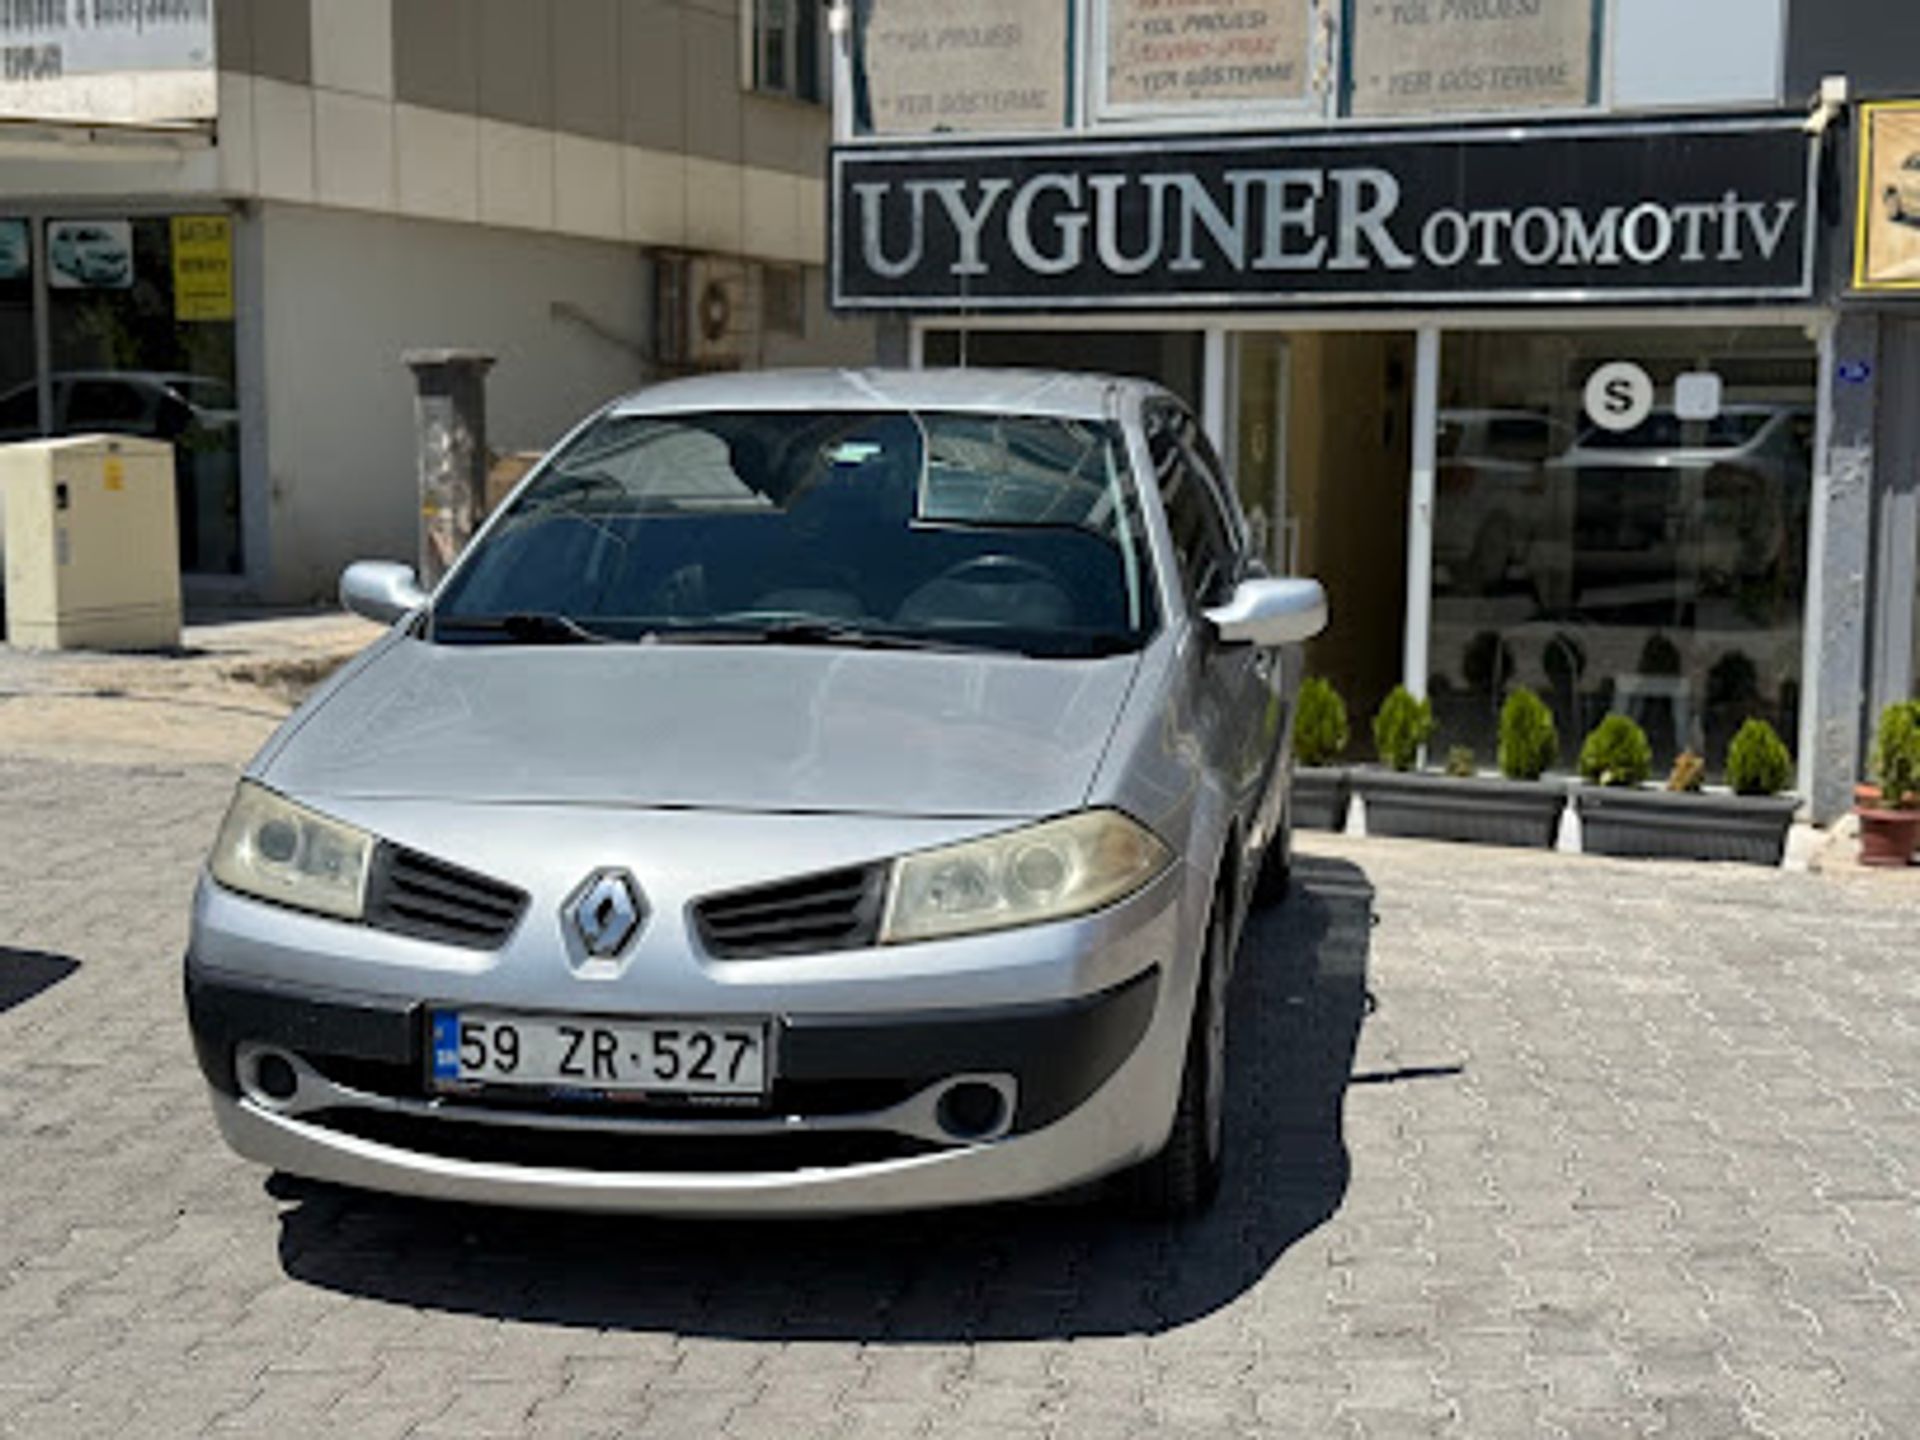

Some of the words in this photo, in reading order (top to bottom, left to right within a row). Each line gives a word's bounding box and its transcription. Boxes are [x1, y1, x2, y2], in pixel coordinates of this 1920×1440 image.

[853, 168, 1415, 279] UYGUNER
[1420, 190, 1796, 266] OTOMOTİV
[1604, 378, 1635, 415] S
[460, 1024, 520, 1074] 59
[558, 1025, 618, 1081] ZR
[652, 1029, 758, 1083] 527
